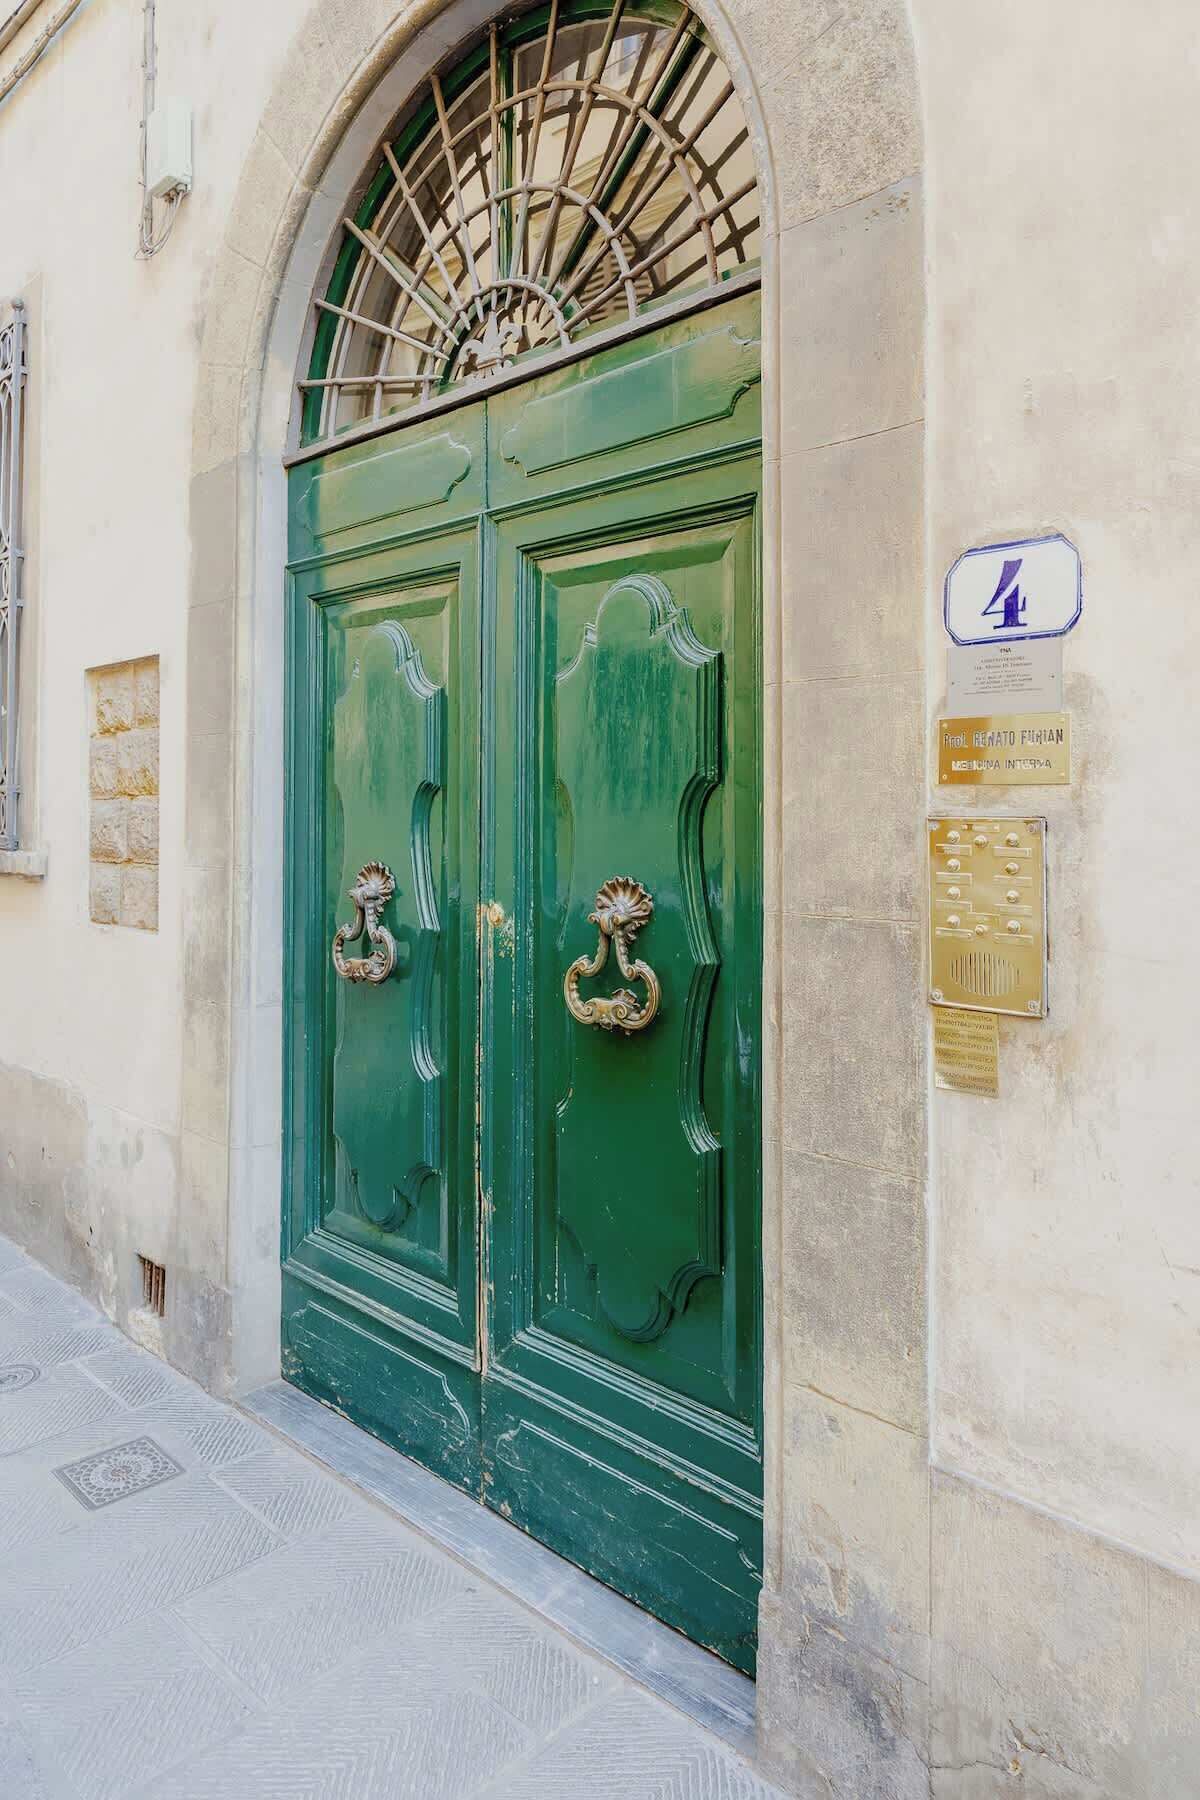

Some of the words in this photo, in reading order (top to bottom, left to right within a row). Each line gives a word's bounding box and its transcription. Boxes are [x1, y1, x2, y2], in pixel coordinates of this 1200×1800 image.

[981, 558, 1027, 629] 4
[974, 730, 1015, 746] RENATO
[1021, 728, 1063, 744] FURIAN
[952, 760, 1000, 770] MEDICINA
[1005, 759, 1052, 769] INTERNA
